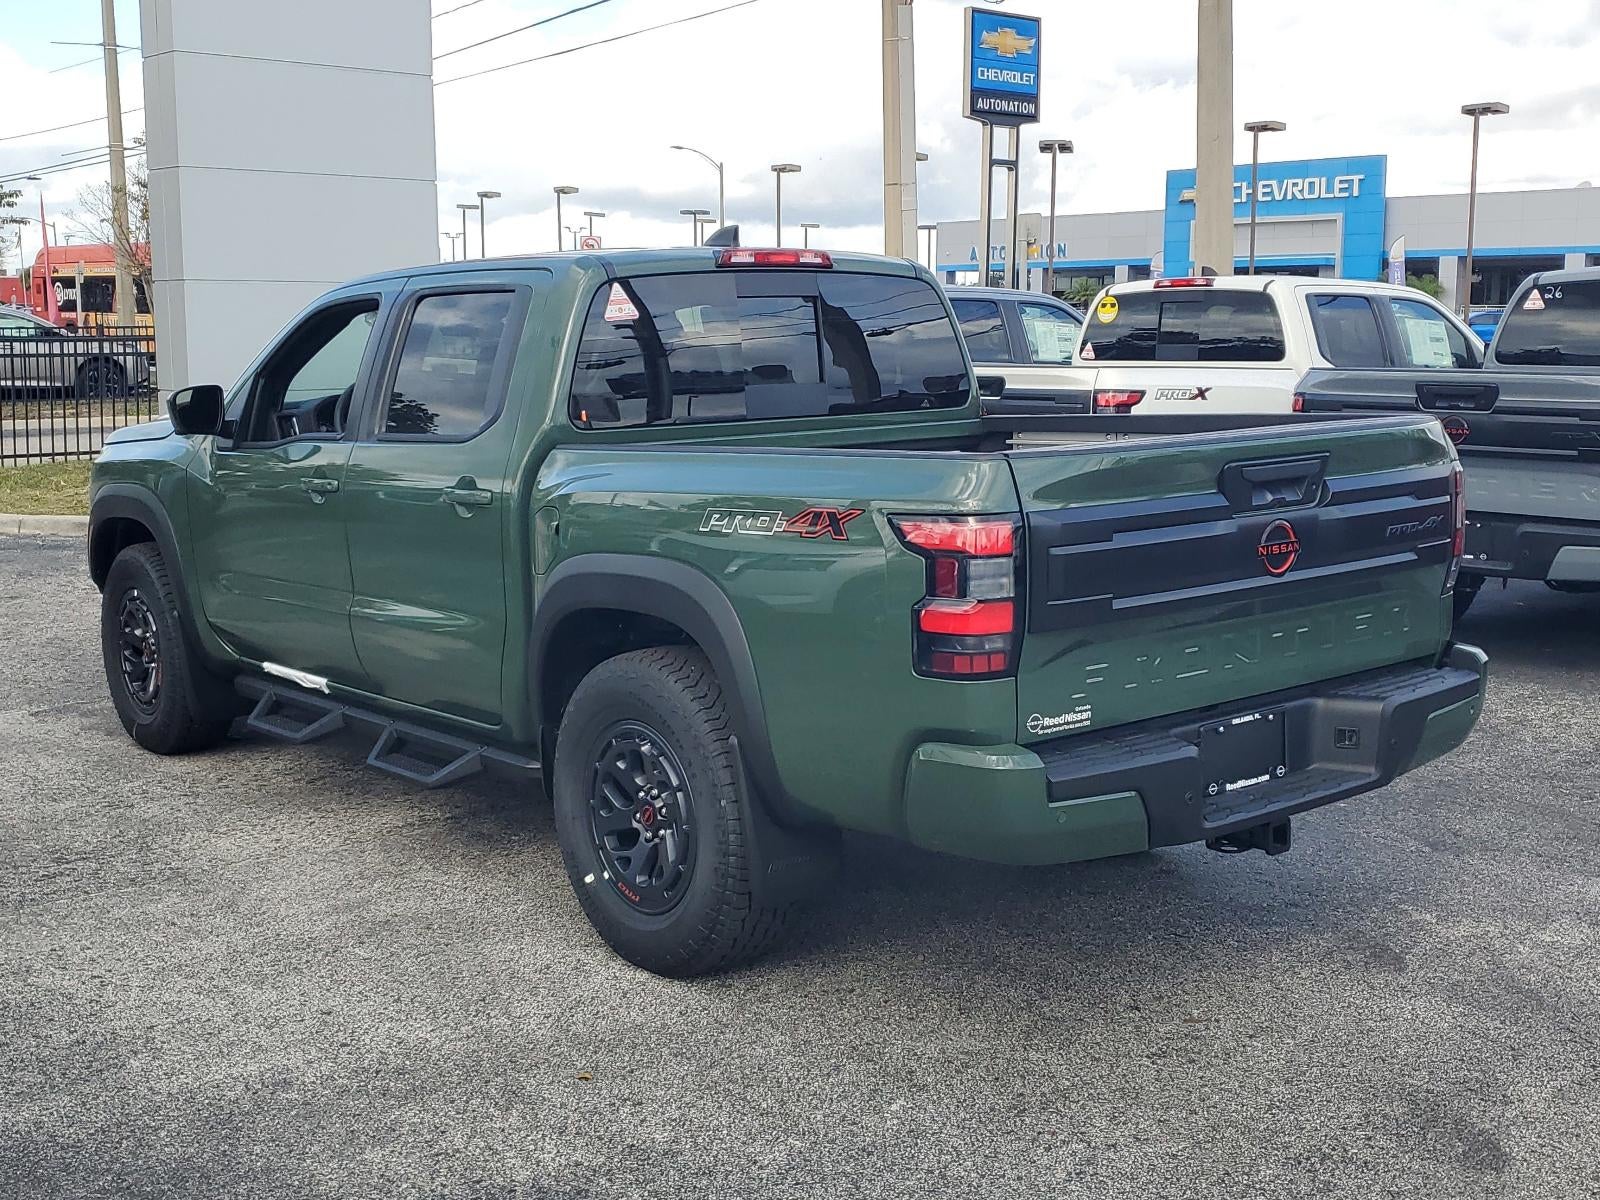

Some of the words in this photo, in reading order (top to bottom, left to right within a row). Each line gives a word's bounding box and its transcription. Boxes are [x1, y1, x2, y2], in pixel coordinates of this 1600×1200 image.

[978, 67, 1035, 85] CHEVROLET
[977, 97, 1035, 114] AUTONATION
[63, 288, 77, 300] LYNX
[1544, 285, 1563, 299] 26
[1154, 386, 1213, 401] PRO-X
[1258, 543, 1300, 556] NISSAN
